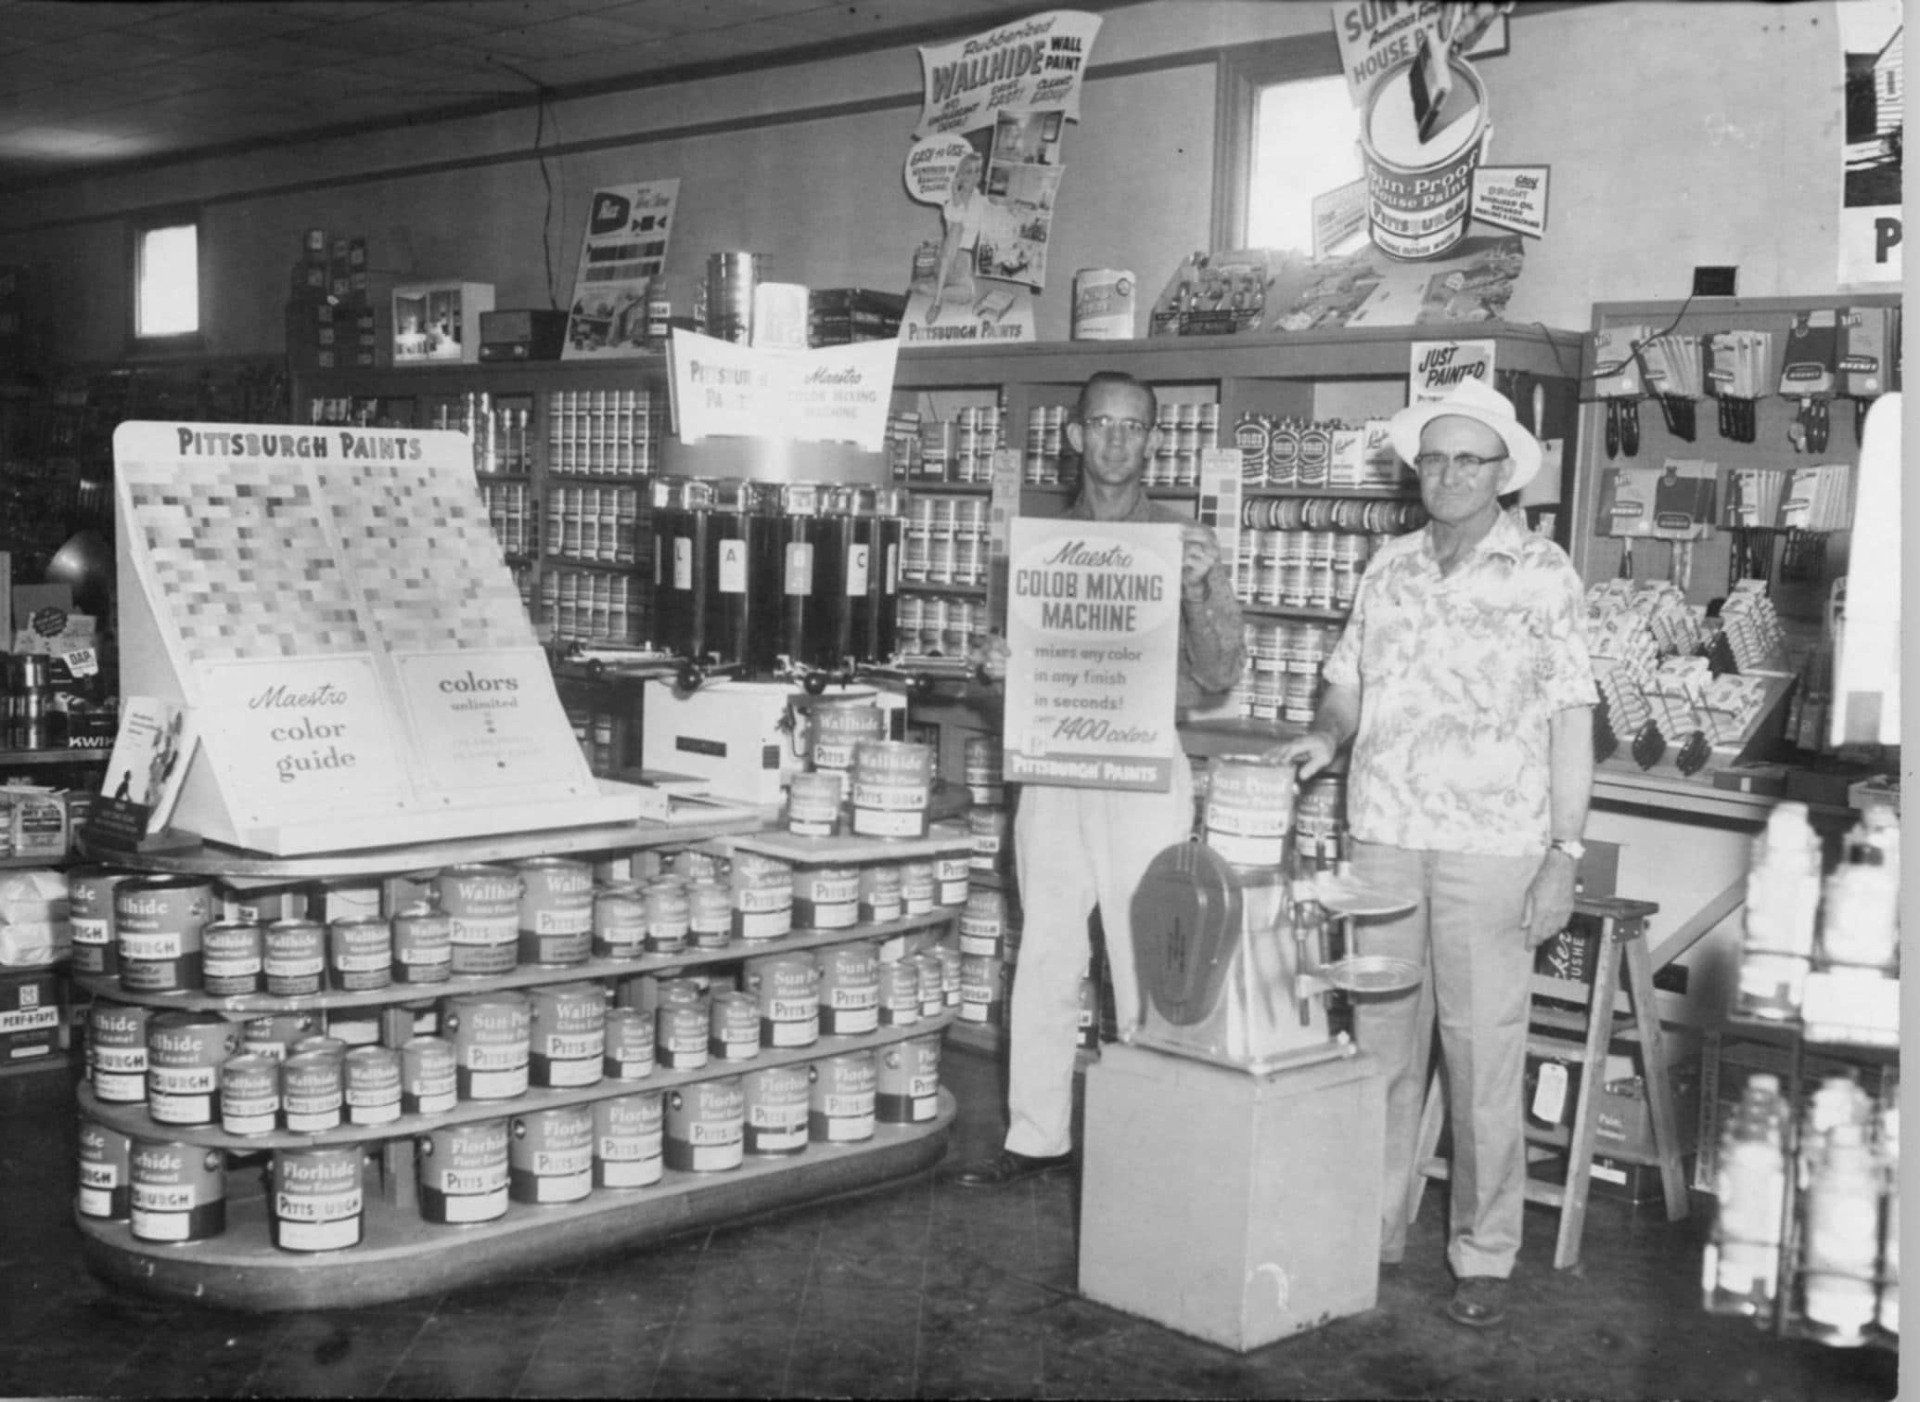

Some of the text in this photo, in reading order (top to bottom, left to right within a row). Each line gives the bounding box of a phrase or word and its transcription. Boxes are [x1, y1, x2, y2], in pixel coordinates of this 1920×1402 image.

[1051, 37, 1081, 51] WALL
[933, 41, 1046, 104] WALLHIDE
[1045, 55, 1081, 71] PAINT
[1352, 34, 1410, 85] HOUSE
[1418, 346, 1460, 373] JUST
[1425, 361, 1486, 389] PAINTED
[177, 427, 423, 460] PITTSBURGH PAINTS
[725, 548, 737, 562] A
[1043, 541, 1134, 567] Maestro
[1086, 572, 1164, 602] MIXING
[1042, 601, 1137, 632] MACHINE
[1080, 649, 1105, 664] any
[1108, 646, 1144, 662] color
[439, 670, 520, 694] colors
[1034, 670, 1127, 688] in any finish
[249, 683, 349, 710] Maestro
[451, 697, 519, 711] unlimited
[1034, 696, 1125, 711] in seconds!
[271, 716, 347, 742] color
[1053, 716, 1109, 742] 1400
[276, 746, 357, 784] guide
[1011, 754, 1158, 782] PITTSBURGH PAINTS
[280, 1195, 360, 1216] PITTSURGH
